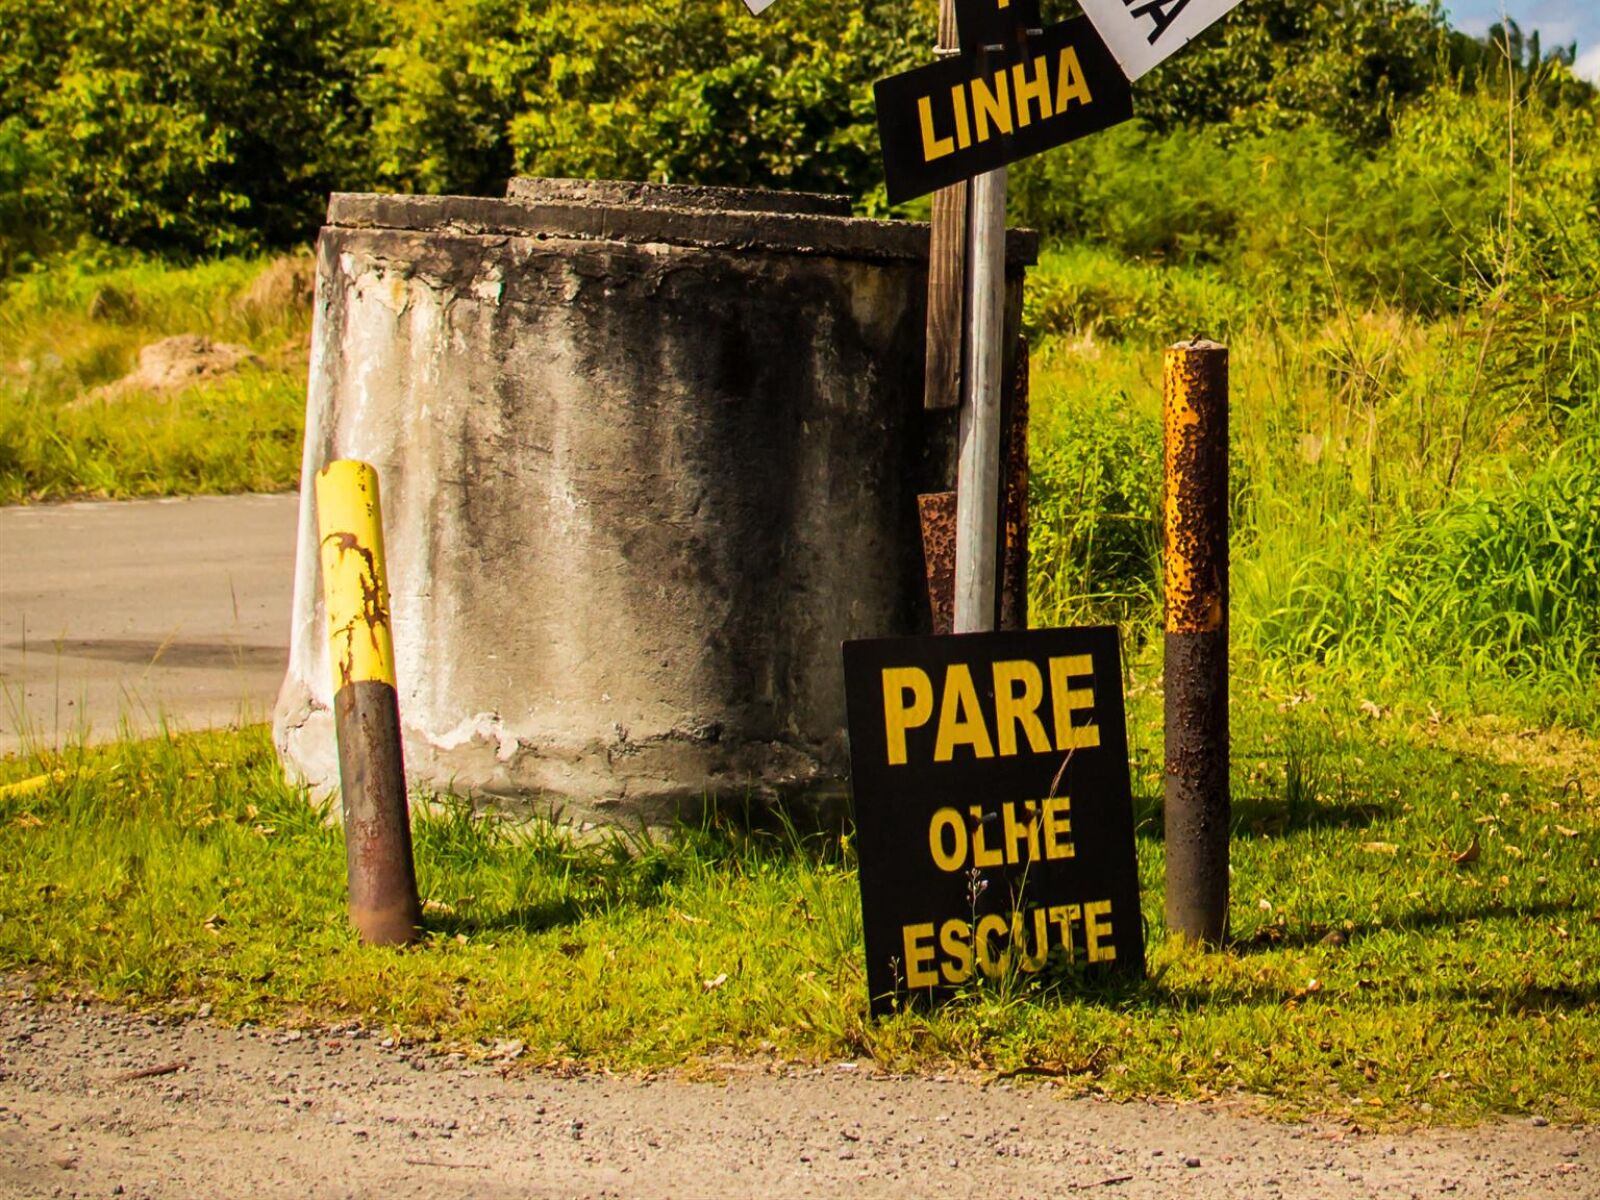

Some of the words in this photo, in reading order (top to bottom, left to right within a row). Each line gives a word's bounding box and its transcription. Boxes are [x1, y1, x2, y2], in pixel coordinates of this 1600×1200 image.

[917, 46, 1092, 162] LINHA
[882, 654, 1100, 765] PARE
[929, 797, 1075, 872] OLHE
[903, 900, 1116, 988] ESCUTE
